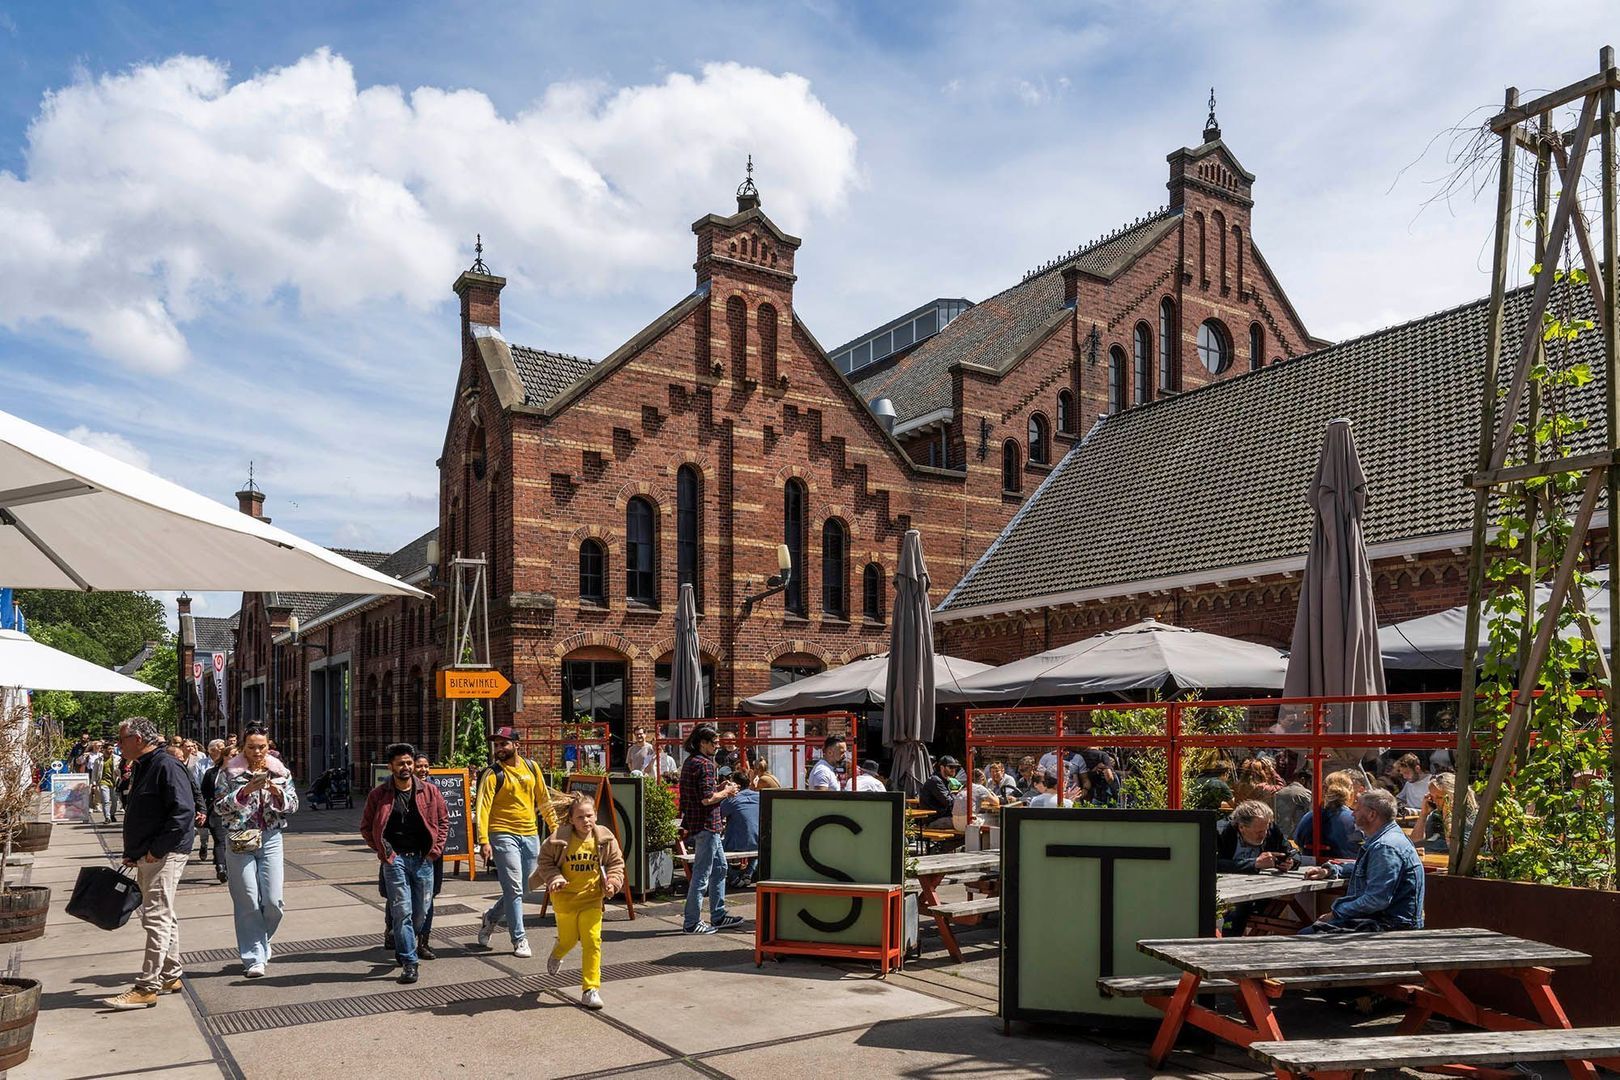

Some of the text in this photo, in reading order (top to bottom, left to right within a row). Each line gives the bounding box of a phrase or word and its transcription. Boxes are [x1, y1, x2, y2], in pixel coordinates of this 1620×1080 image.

[450, 678, 498, 688] BIERWINKEL
[570, 864, 595, 872] TODAY
[797, 814, 863, 933] S
[1046, 844, 1171, 998] T
